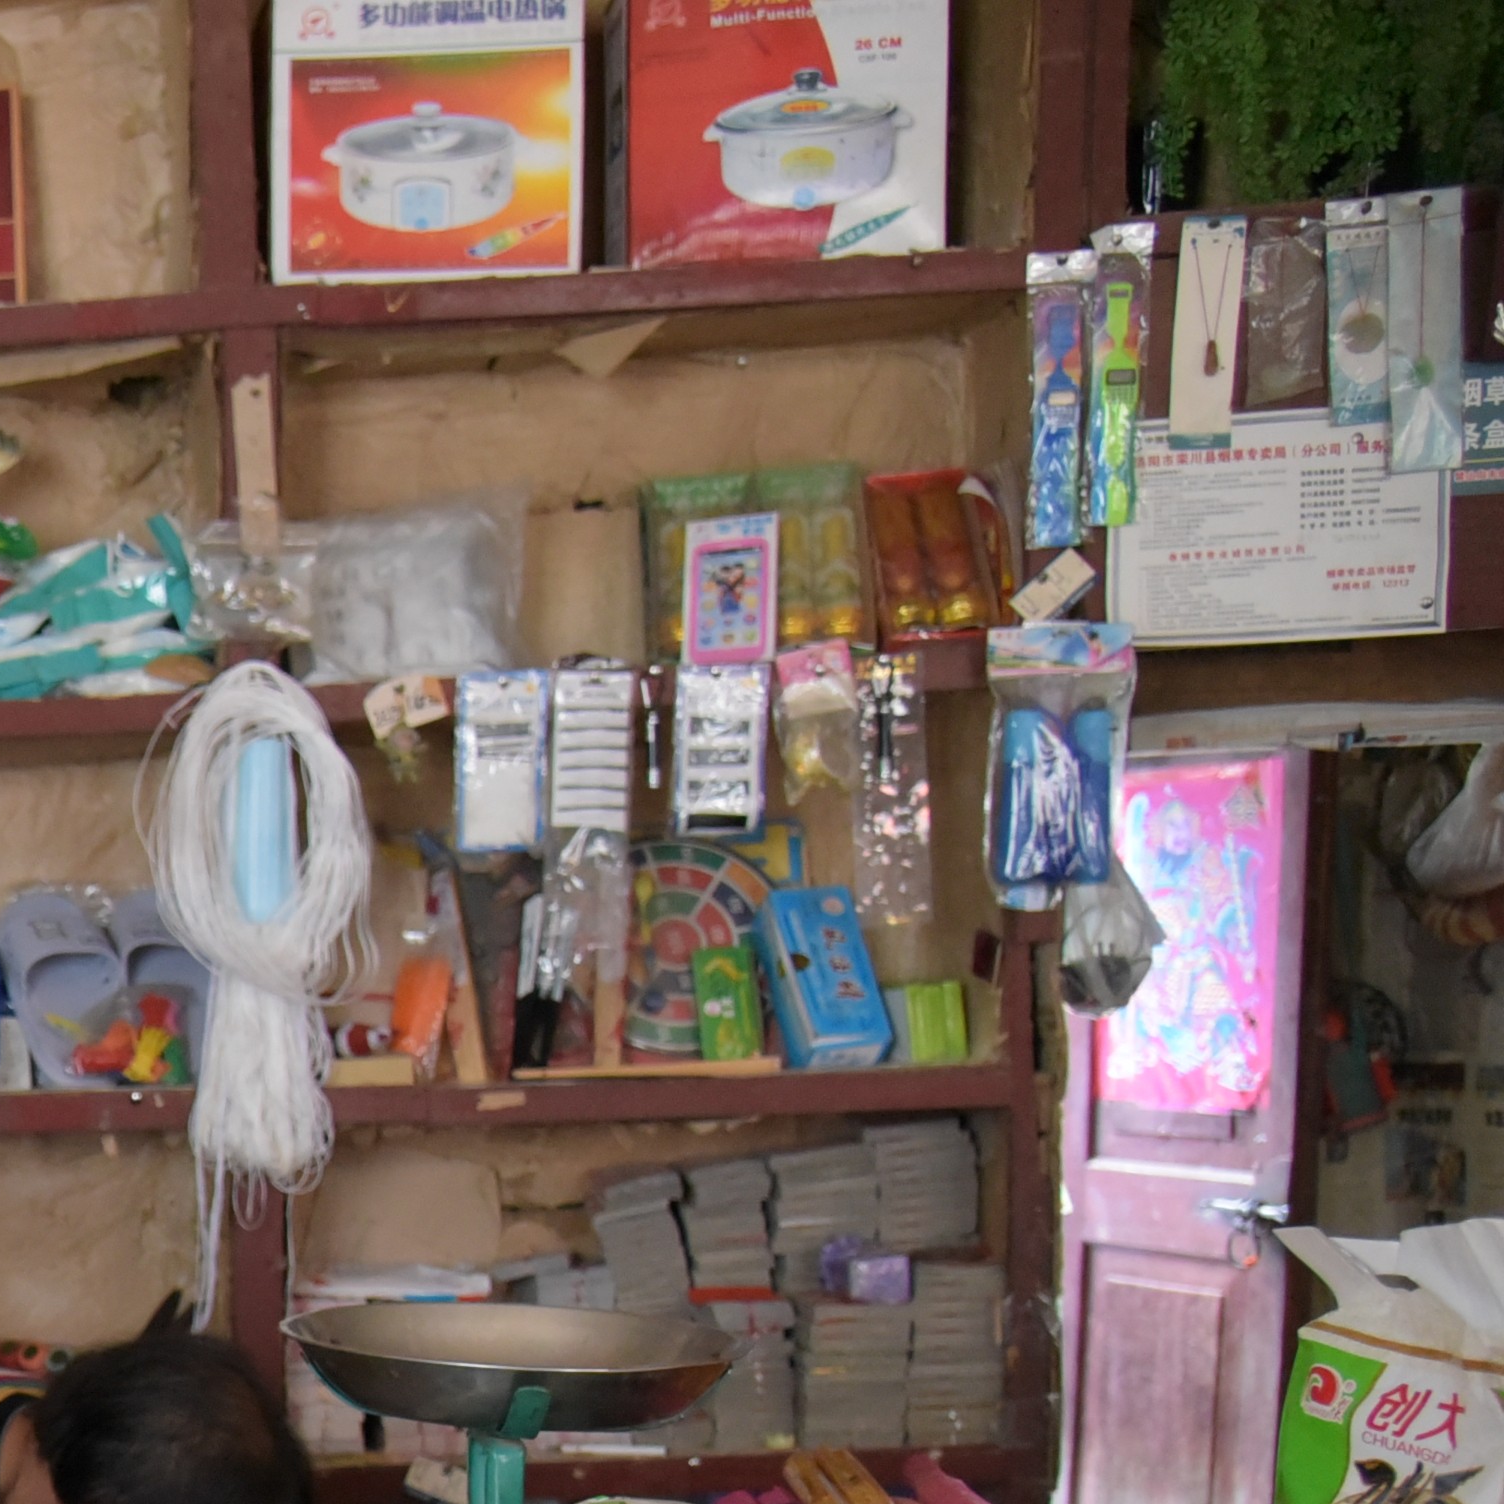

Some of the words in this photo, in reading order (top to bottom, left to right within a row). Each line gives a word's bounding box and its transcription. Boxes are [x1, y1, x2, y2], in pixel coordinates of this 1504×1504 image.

[855, 39, 872, 51] 26
[878, 37, 902, 49] CM
[1366, 1383, 1465, 1450] 创大
